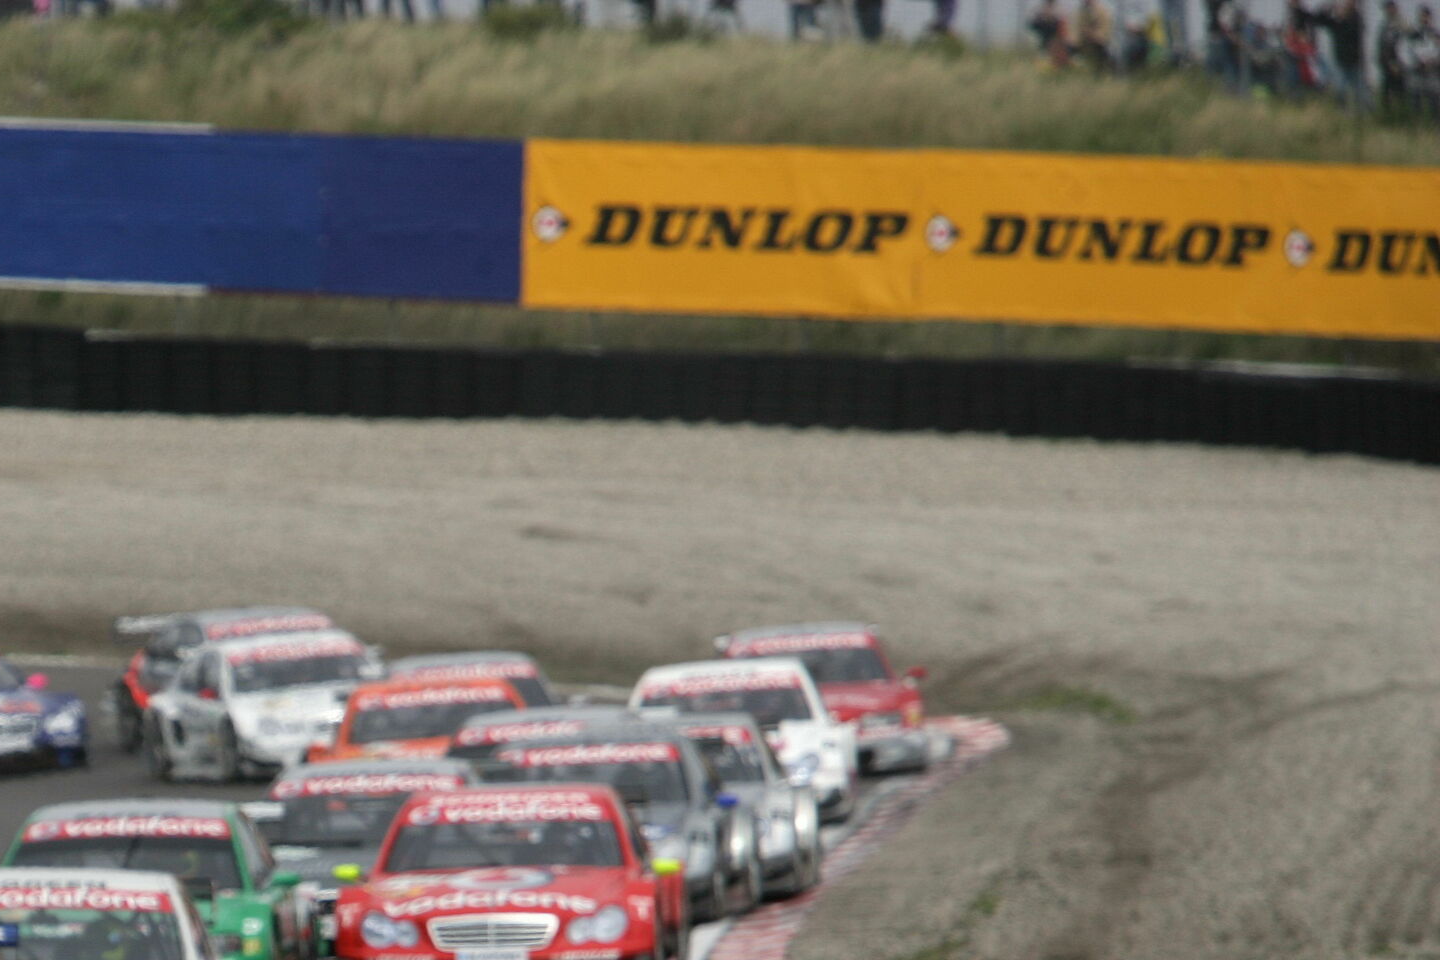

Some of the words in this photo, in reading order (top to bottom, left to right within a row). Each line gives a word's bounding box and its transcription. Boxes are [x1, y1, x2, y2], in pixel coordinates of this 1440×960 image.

[583, 204, 910, 253] DUNLOP
[977, 213, 1272, 268] DUNLOP
[445, 800, 601, 820] vodafone
[64, 817, 225, 837] vodafone
[383, 890, 597, 916] vodafone
